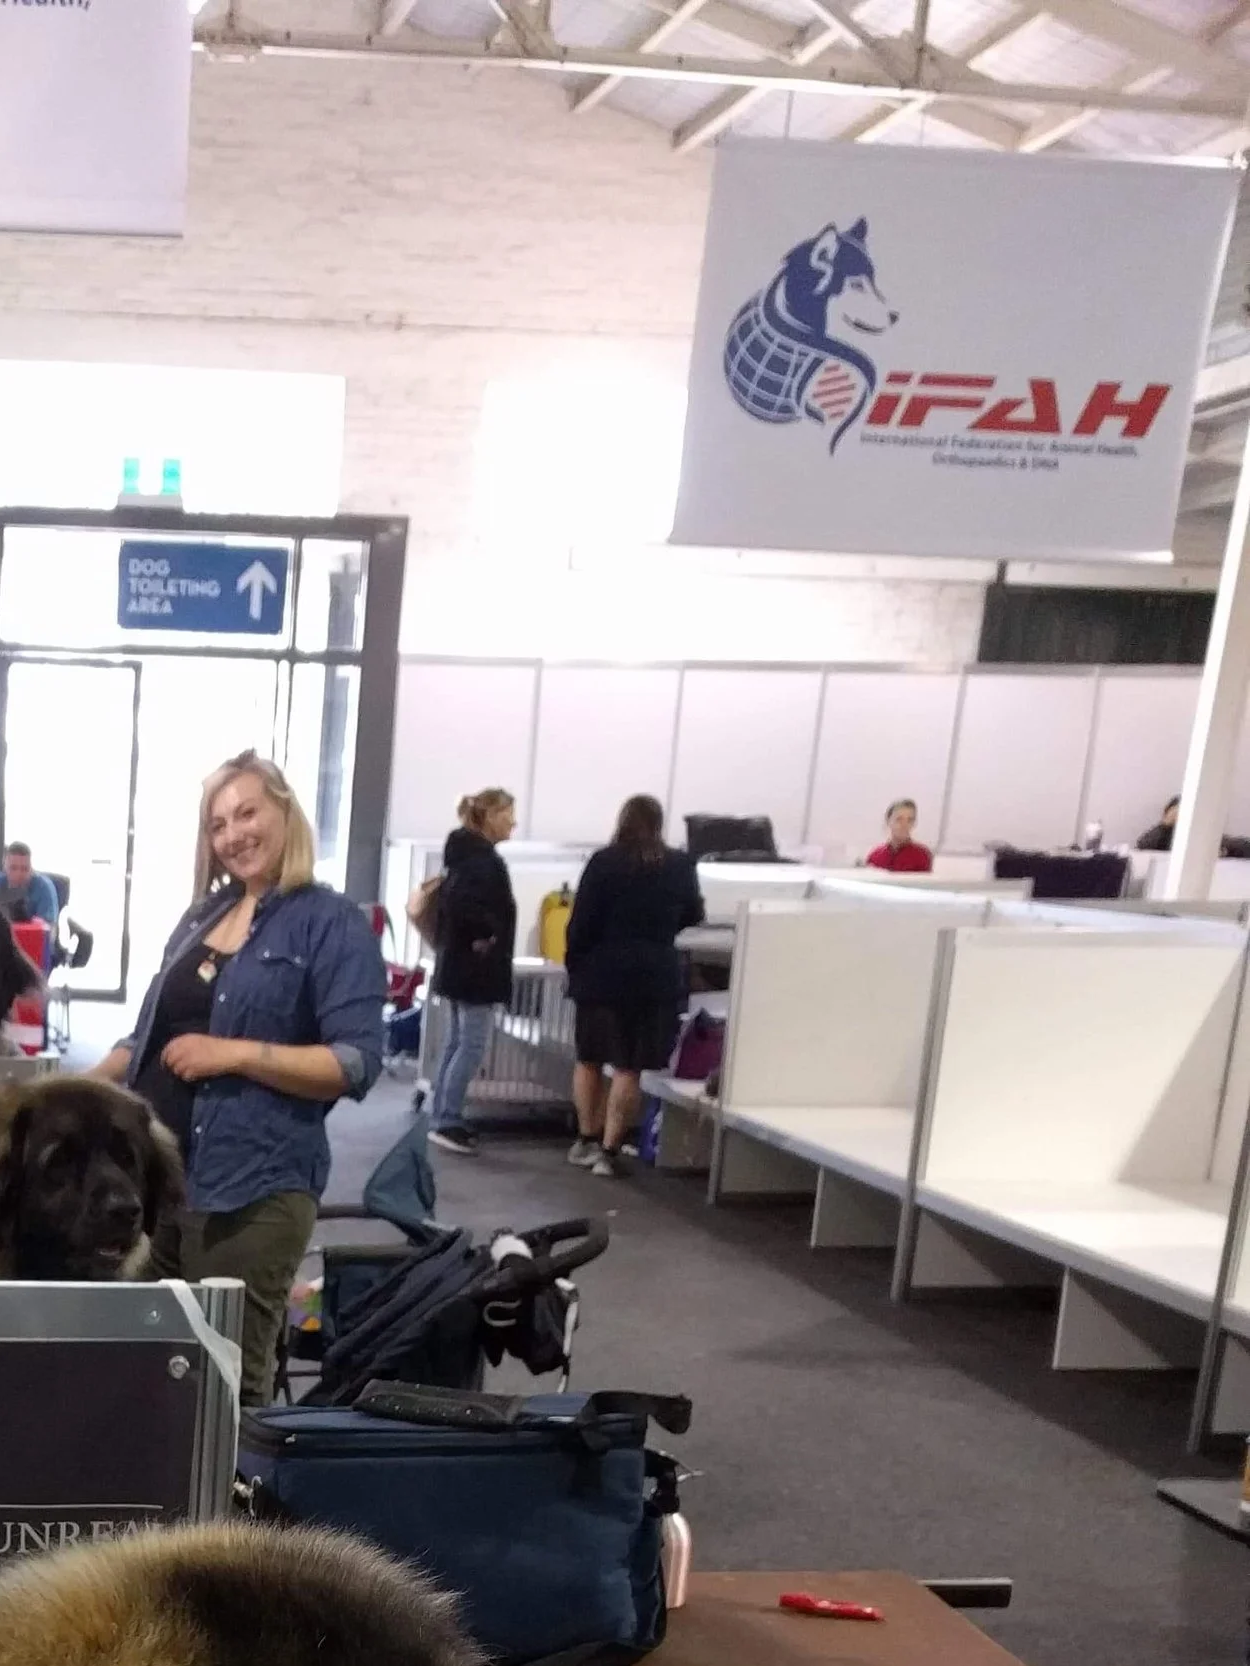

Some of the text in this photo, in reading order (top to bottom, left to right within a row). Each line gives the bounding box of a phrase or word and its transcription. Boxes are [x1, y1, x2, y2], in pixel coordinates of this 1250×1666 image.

[128, 558, 170, 576] DOG
[128, 578, 222, 597] TOILETING
[126, 597, 174, 614] AREA
